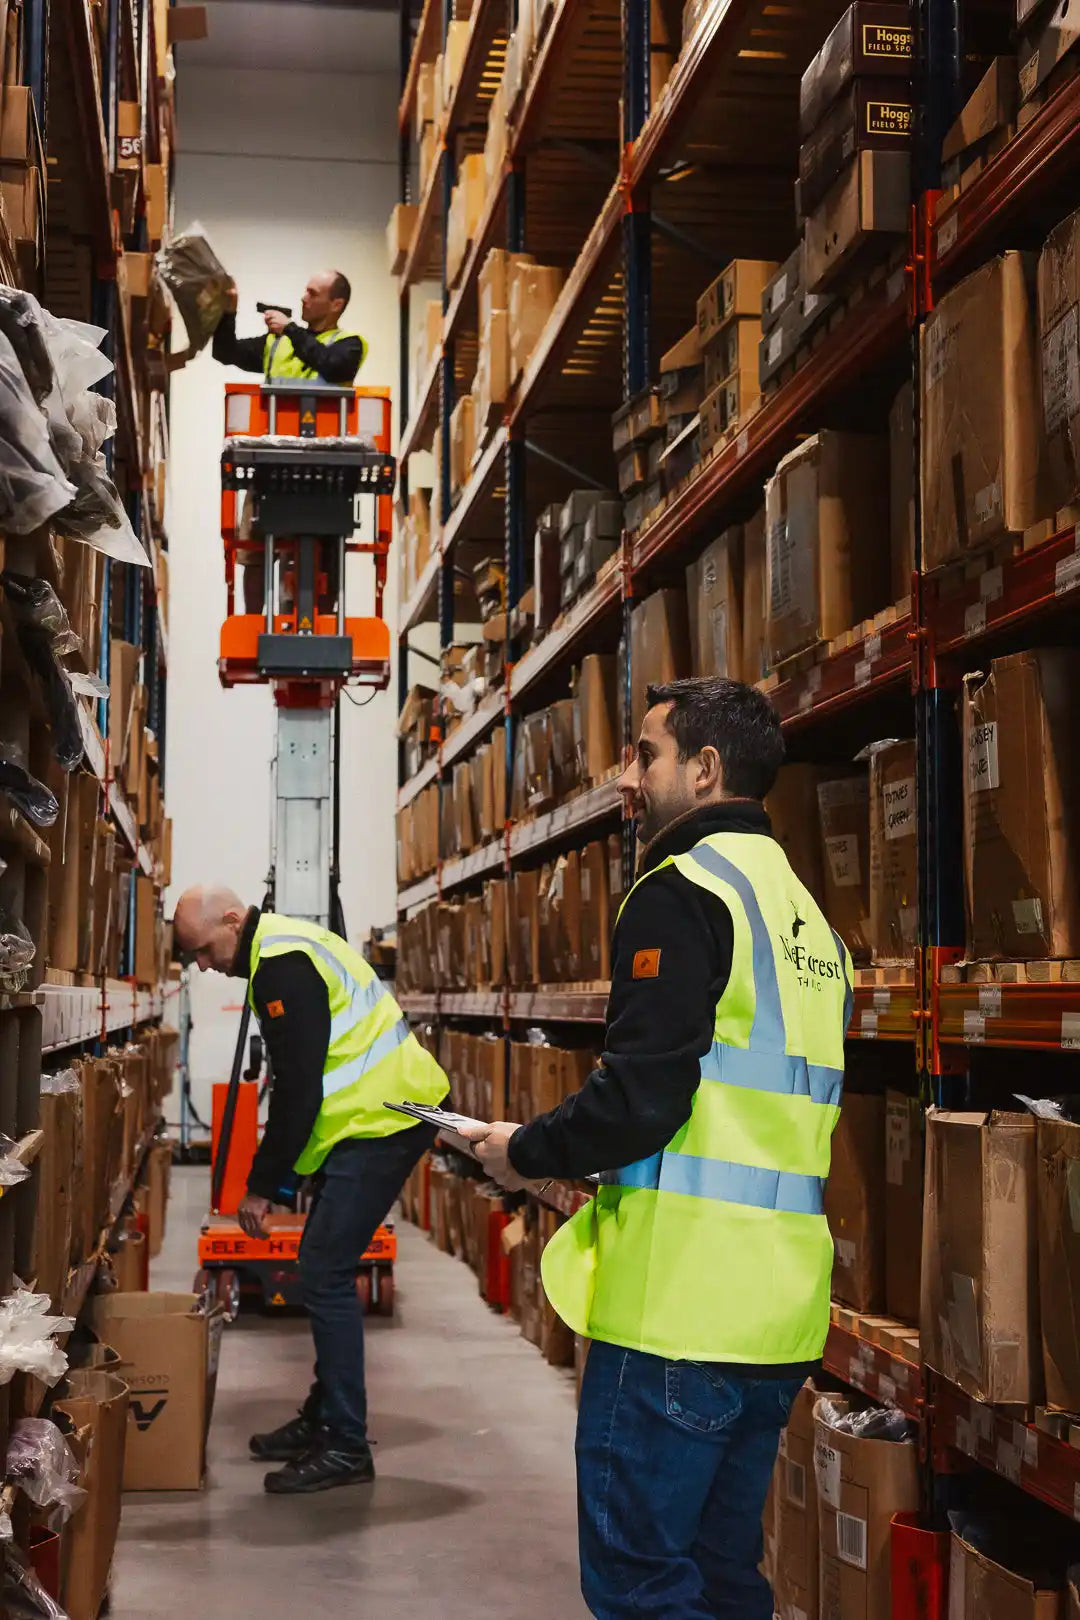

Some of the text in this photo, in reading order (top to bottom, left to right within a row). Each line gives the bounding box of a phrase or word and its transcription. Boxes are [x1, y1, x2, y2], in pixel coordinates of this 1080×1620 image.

[868, 43, 891, 52] FIELD
[872, 120, 912, 130] FIELD SP
